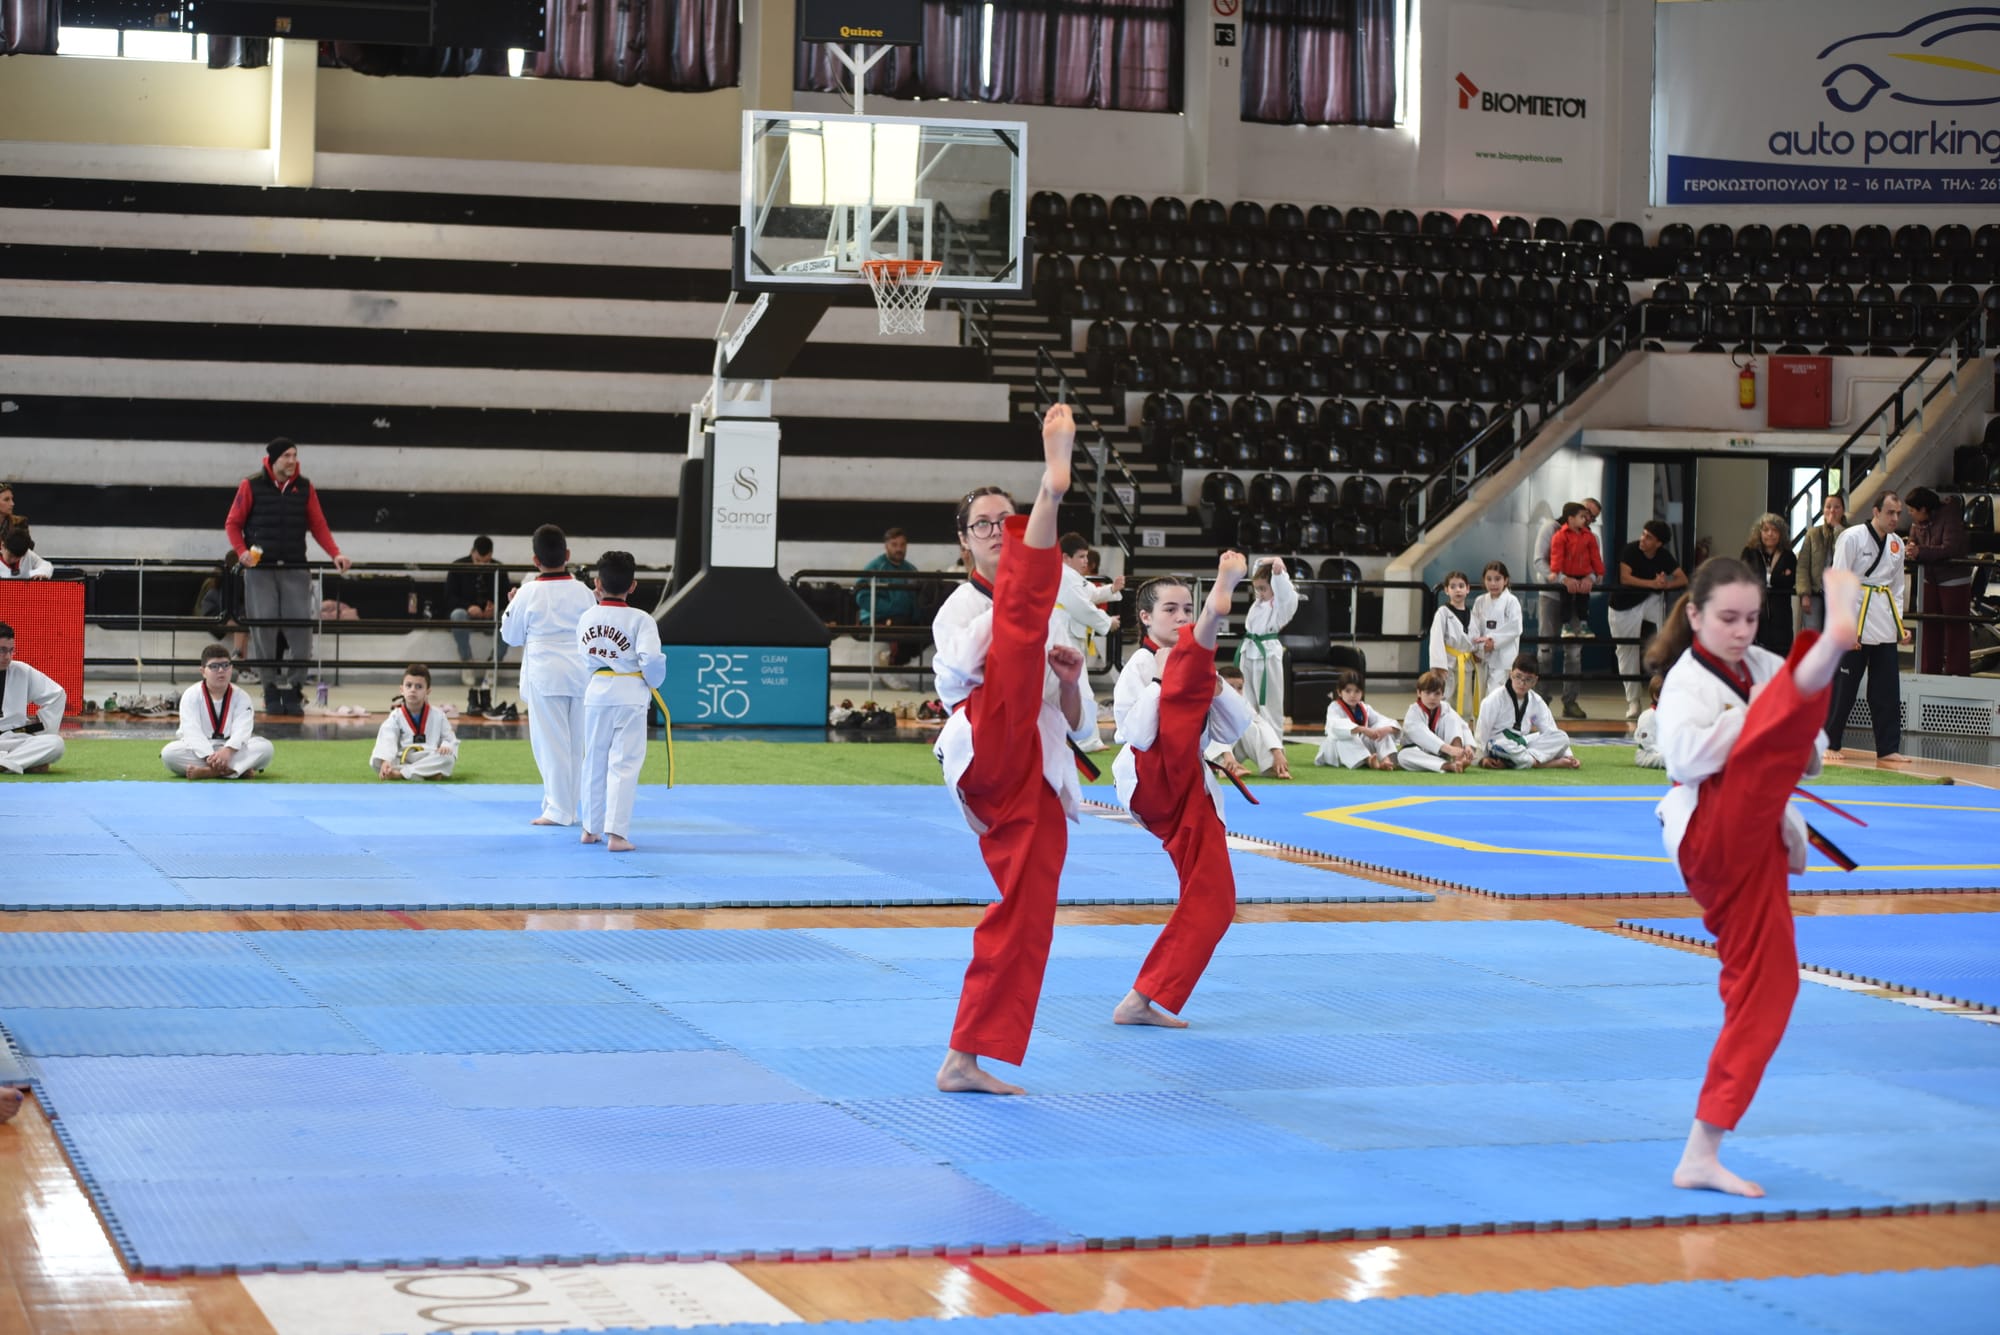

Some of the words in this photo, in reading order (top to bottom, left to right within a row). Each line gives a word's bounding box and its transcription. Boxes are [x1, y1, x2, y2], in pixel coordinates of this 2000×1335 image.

[840, 26, 884, 38] Quince
[1768, 120, 1855, 155] auto
[1864, 120, 2000, 164] parking
[1475, 151, 1563, 163] www.biompeton.com
[1684, 178, 1829, 192] ΓΕΡΟΚΩΣΤΟΠΟΥΛΟΥ
[1834, 178, 1848, 191] 12
[1865, 178, 1879, 191] 16
[1884, 178, 1932, 191] ΠΑΤΡΑ
[1941, 178, 1976, 191] ΤΗΛ:
[717, 507, 773, 524] Samar
[582, 625, 631, 652] TAEKWONDO
[761, 655, 788, 664] CLEAN
[761, 666, 785, 674] GIVES
[761, 677, 789, 685] VALUE!
